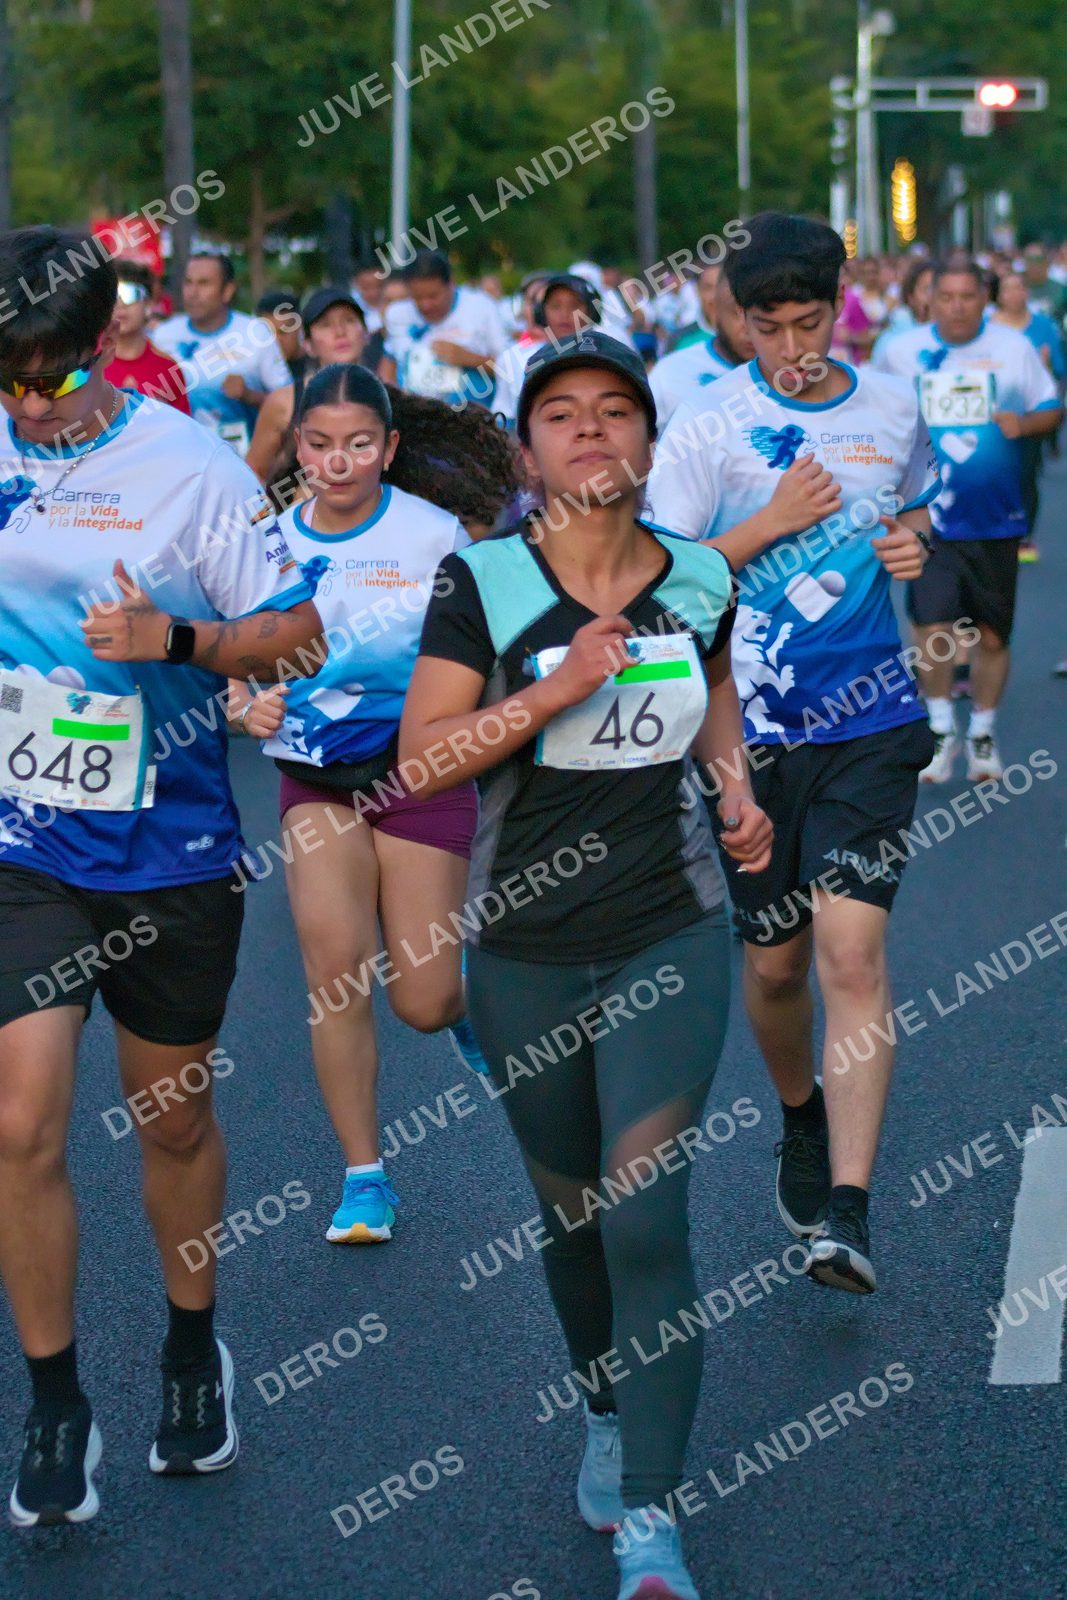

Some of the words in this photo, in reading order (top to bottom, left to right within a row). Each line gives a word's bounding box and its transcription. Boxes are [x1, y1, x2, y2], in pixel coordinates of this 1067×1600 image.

[927, 396, 985, 418] 1932
[820, 433, 875, 444] Carrera
[853, 444, 876, 453] Vida
[843, 454, 893, 465] Integridad
[52, 488, 120, 504] Carrera
[50, 505, 72, 517] por
[75, 504, 86, 515] la
[90, 504, 119, 516] Vida
[73, 517, 143, 531] Integridad
[345, 559, 399, 569] Carrera
[376, 569, 400, 578] Vida
[365, 578, 418, 589] Integridad
[588, 691, 664, 750] 46
[8, 731, 112, 793] 648
